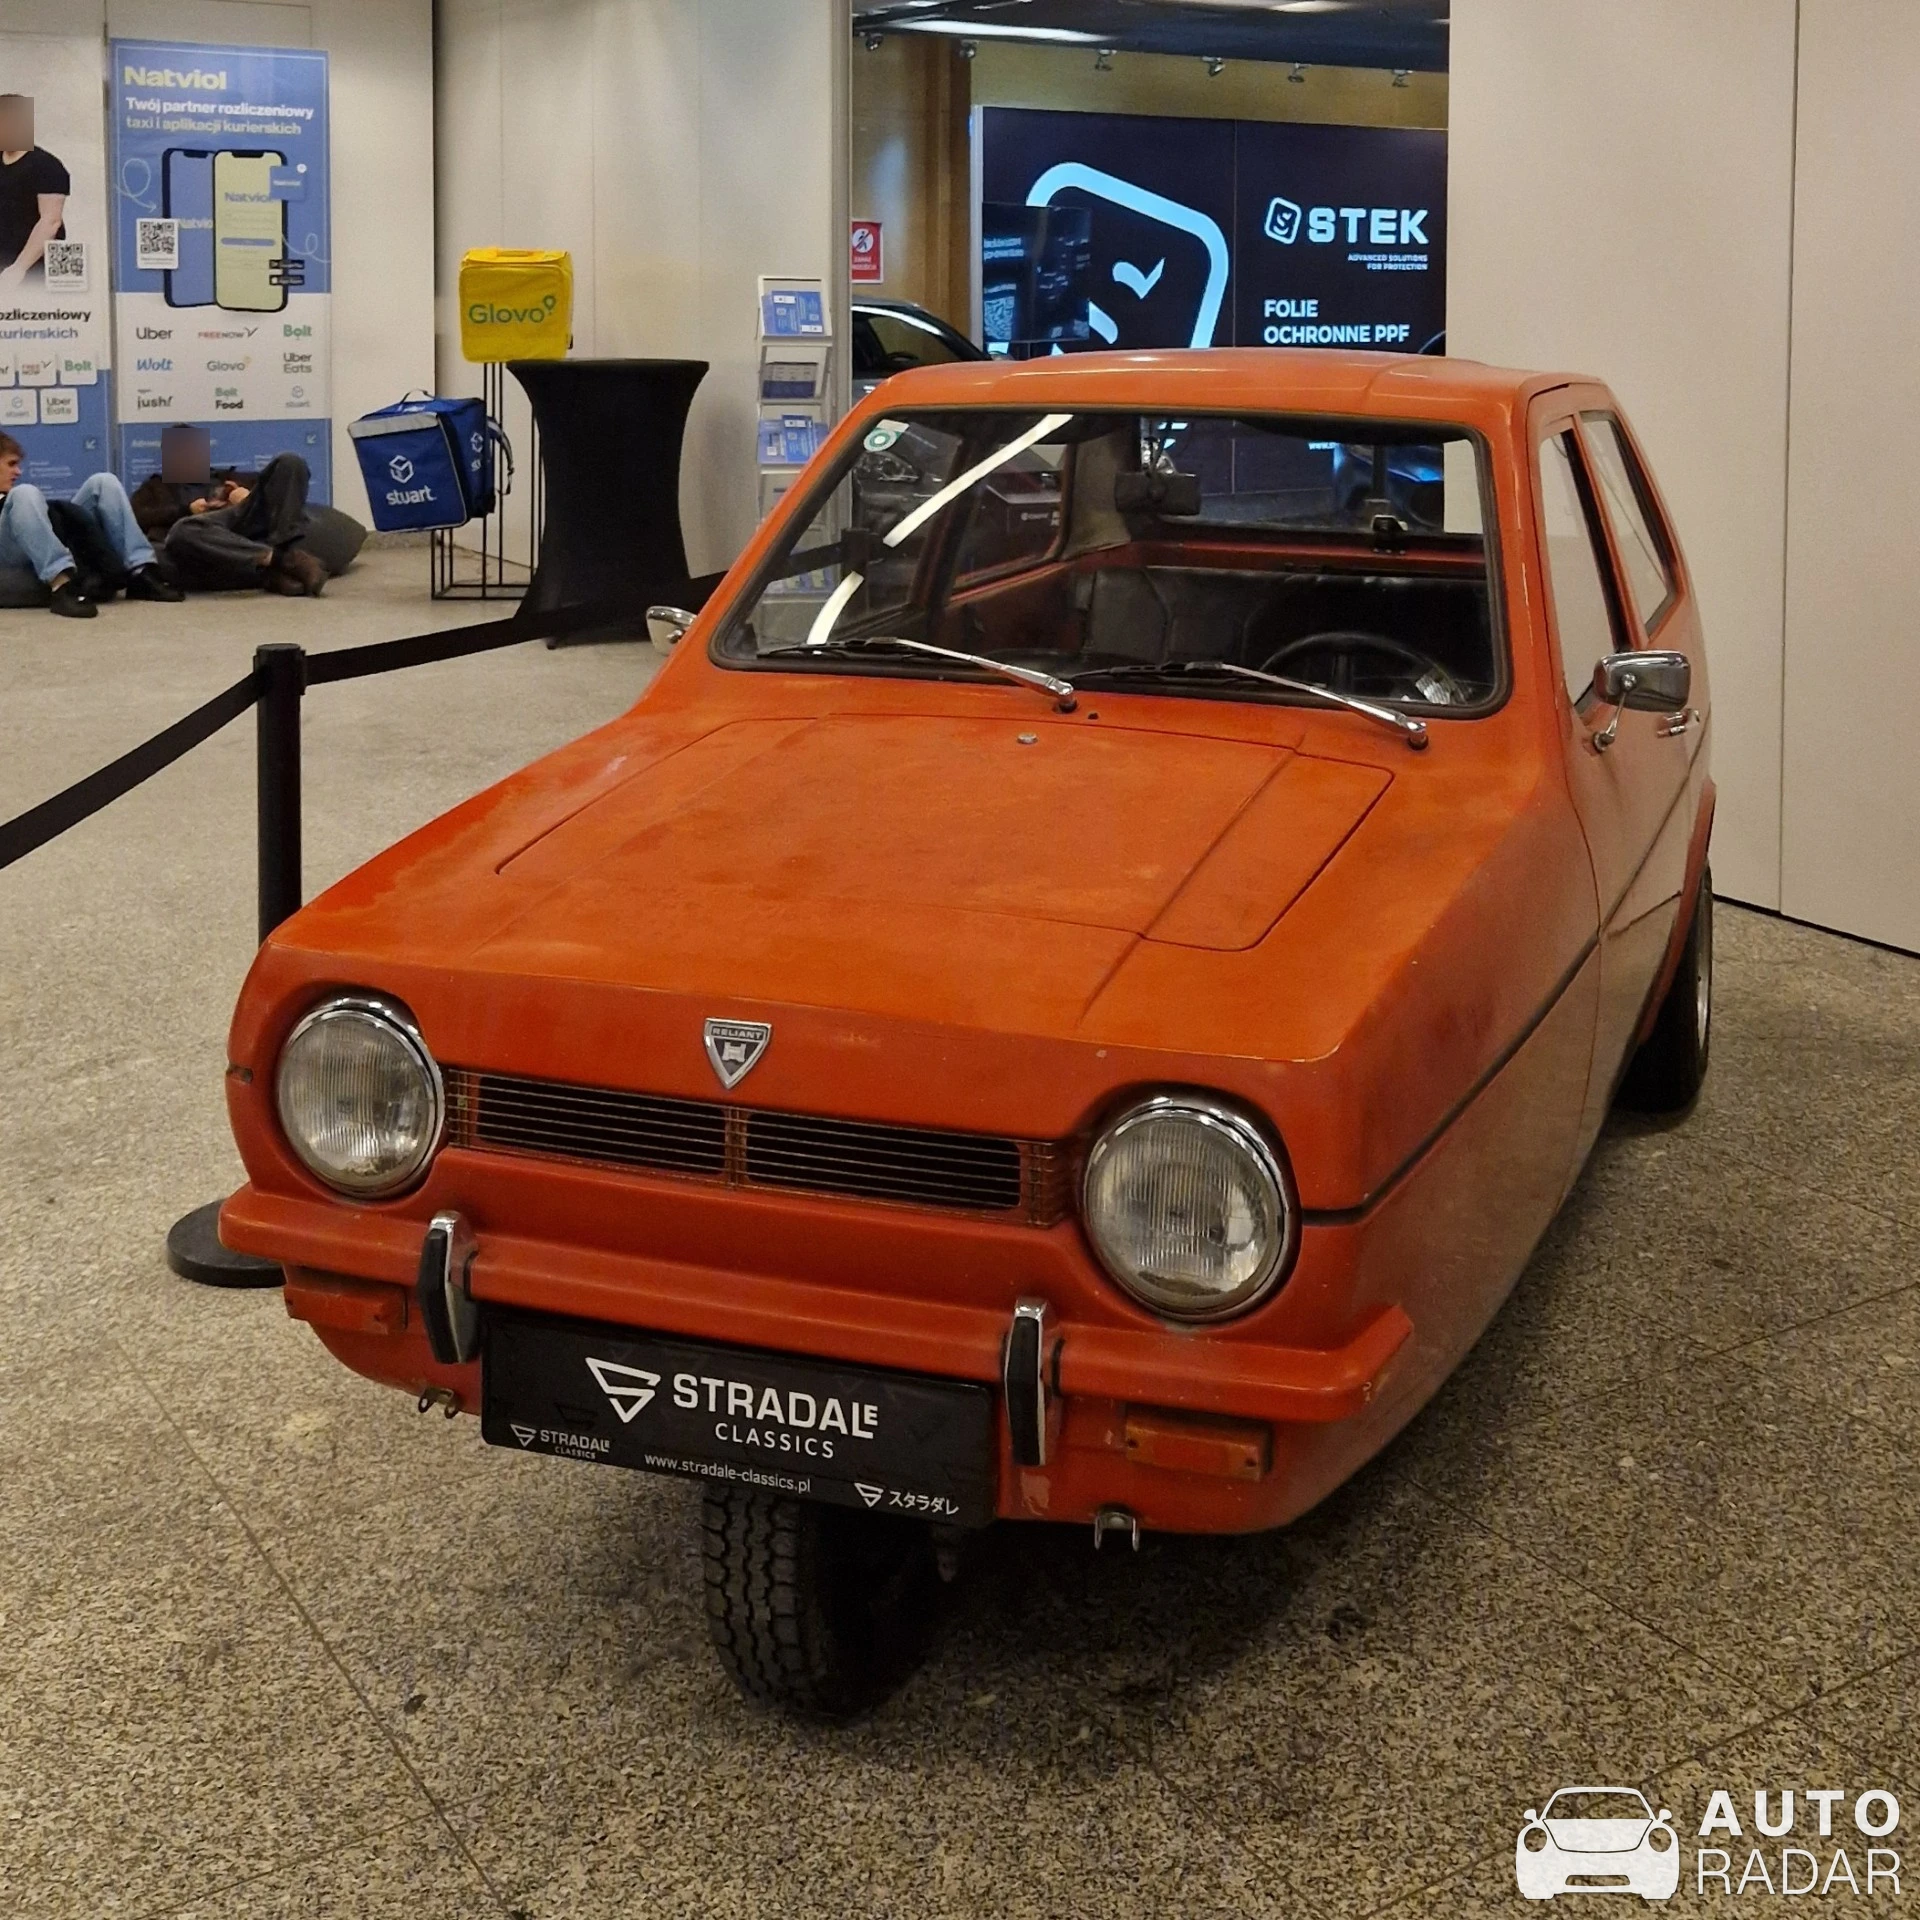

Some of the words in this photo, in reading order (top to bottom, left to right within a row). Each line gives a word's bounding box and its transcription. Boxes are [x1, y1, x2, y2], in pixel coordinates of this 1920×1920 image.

[124, 66, 227, 90] Natviol
[126, 97, 161, 113] Twój
[163, 100, 215, 115] partner
[218, 102, 314, 120] rozliczeniowy
[126, 115, 154, 128] taxi
[163, 117, 222, 134] aplikacji
[223, 119, 301, 134] kurierskich
[1308, 207, 1429, 244] STEK
[1347, 254, 1388, 262] ADVANCED
[1388, 254, 1428, 262] SOLUTIONS
[1366, 262, 1382, 270] FOR
[1383, 263, 1428, 271] PROTECTION
[468, 303, 545, 325] Glovo
[1264, 299, 1319, 318] FOLIE
[136, 327, 173, 340] Uber
[283, 324, 312, 338] Bolt
[1263, 325, 1371, 344] OCHRONNE
[1374, 324, 1411, 343] PPF
[64, 360, 92, 372] Bolt
[136, 358, 173, 371] Wolt
[206, 360, 246, 371] Glovo
[283, 353, 312, 363] Uber
[283, 363, 312, 374] Eats
[215, 399, 243, 410] Food
[386, 485, 434, 506] stuart
[712, 1027, 762, 1039] RELIANT
[673, 1373, 879, 1439] STRADALE
[540, 1429, 611, 1453] STRADALE
[715, 1422, 834, 1459] CLASSICS
[555, 1446, 596, 1460] CLASSICS
[644, 1453, 812, 1493] www.stradale-classics.pl
[888, 1491, 960, 1515] スタラダレ
